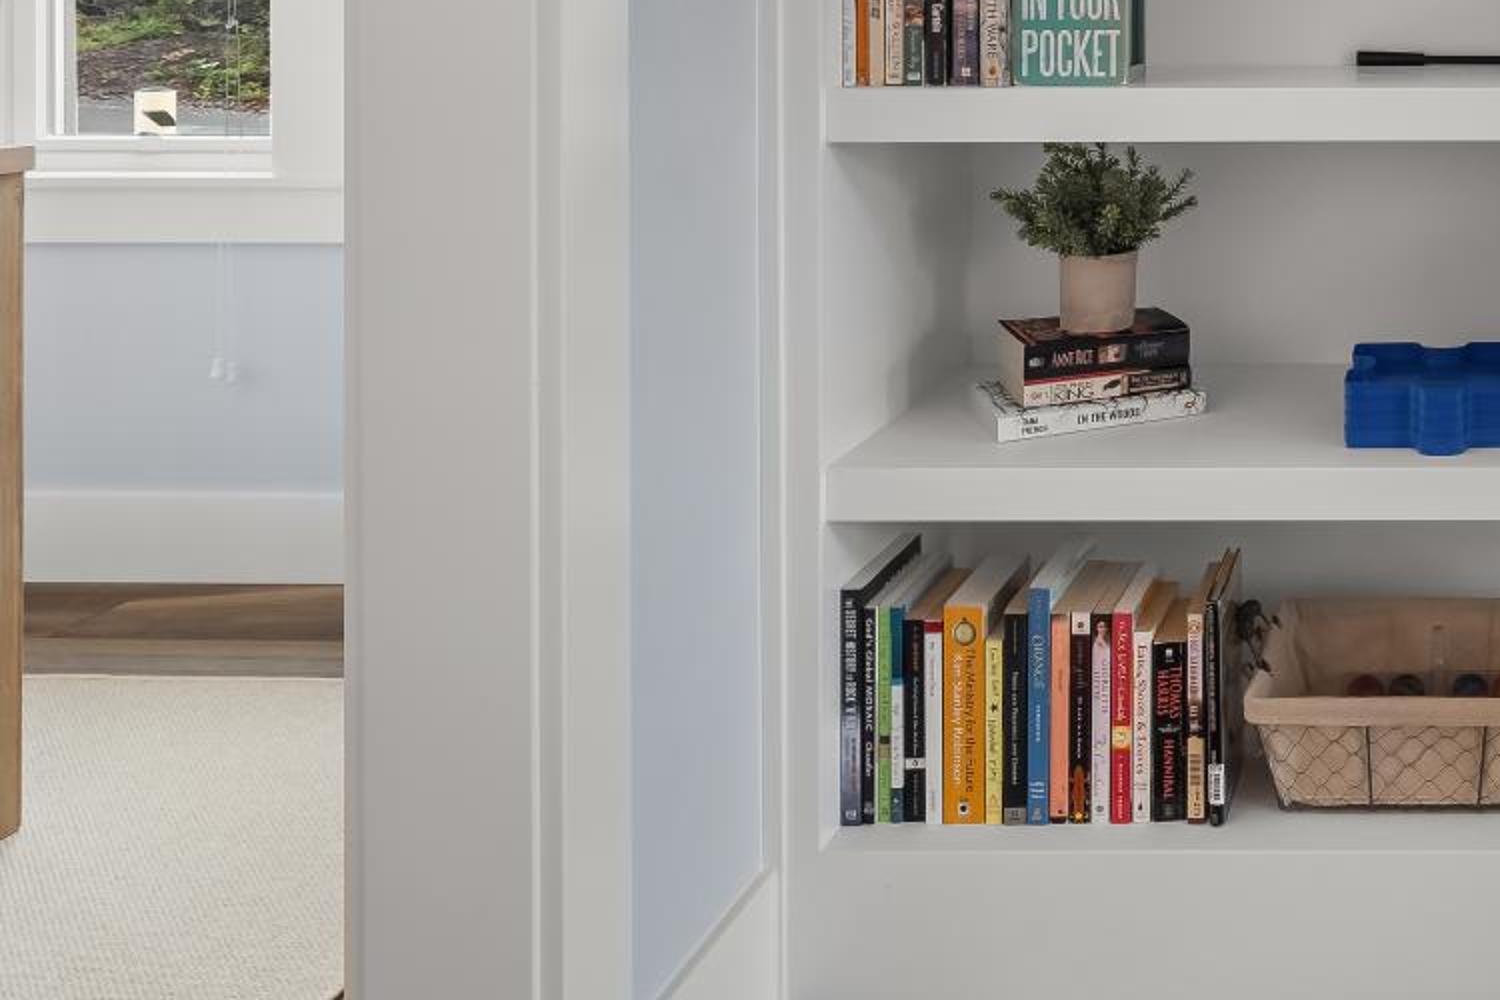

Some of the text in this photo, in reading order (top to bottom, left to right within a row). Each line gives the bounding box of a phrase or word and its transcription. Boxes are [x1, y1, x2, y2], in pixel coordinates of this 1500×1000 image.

[986, 22, 998, 59] WARE
[1021, 30, 1121, 77] POCKET
[1052, 349, 1075, 367] ANNE
[865, 686, 873, 731] MOSAIC
[1157, 669, 1170, 716] HARRIS
[1170, 664, 1183, 720] THOMAS
[951, 654, 963, 784] Kim Stanley Robinson
[964, 648, 977, 793] The Ministry for the Future
[1136, 721, 1147, 733] &
[1162, 739, 1174, 799] HANNIBAL
